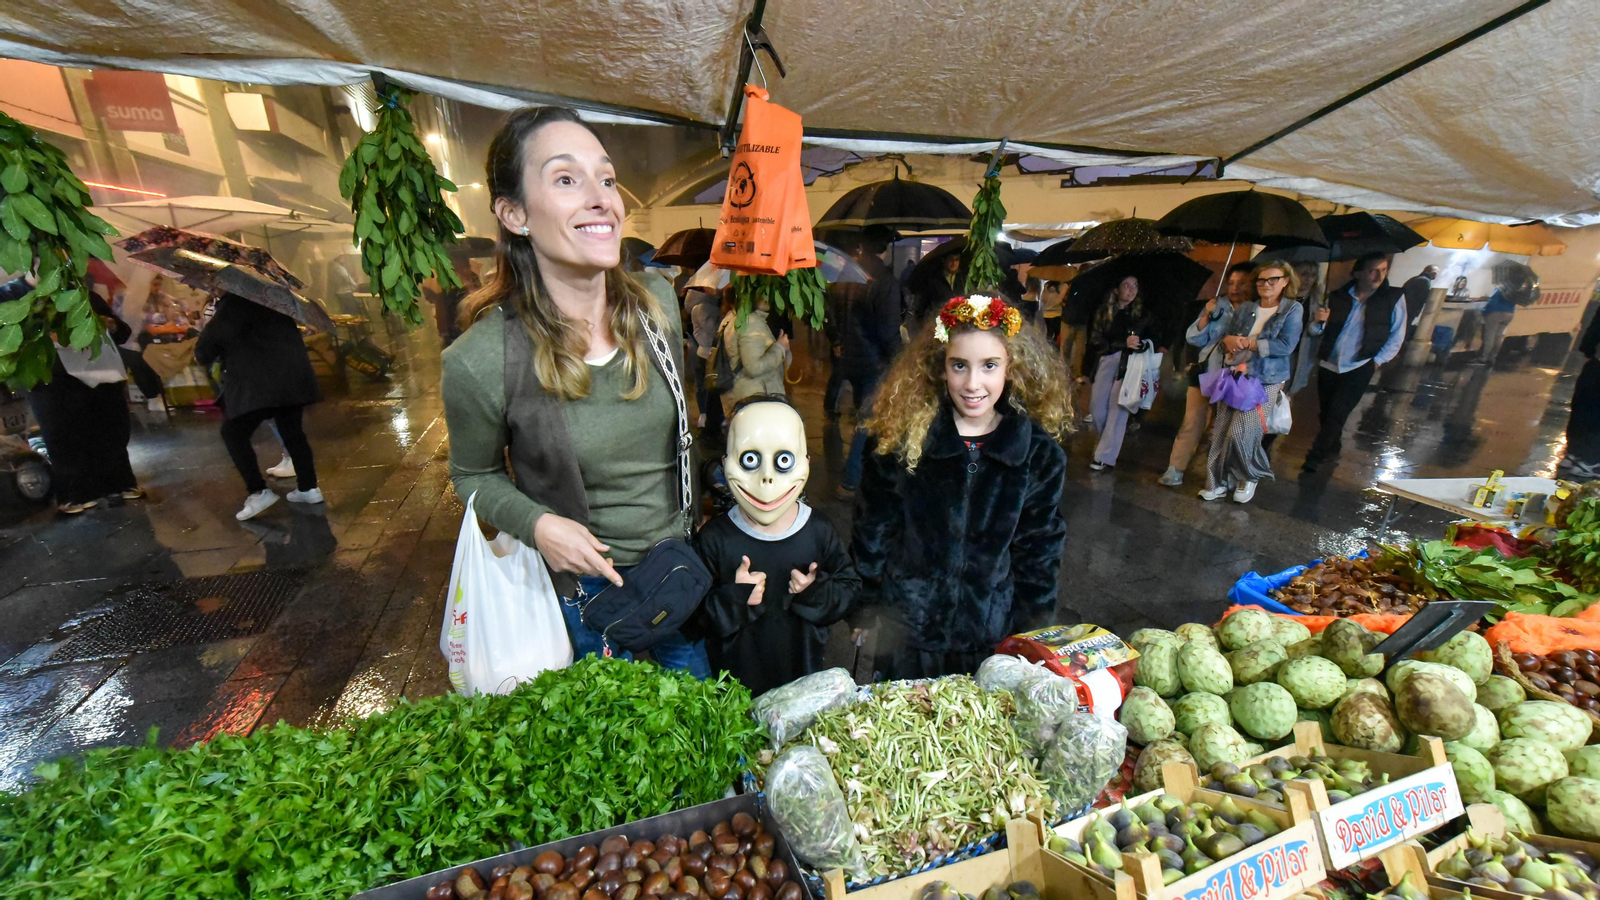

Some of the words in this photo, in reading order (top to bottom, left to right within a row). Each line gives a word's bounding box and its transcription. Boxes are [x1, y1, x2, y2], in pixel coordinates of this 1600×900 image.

[106, 105, 165, 121] suma
[1335, 801, 1391, 854] David
[1390, 797, 1408, 829] &
[1405, 785, 1448, 829] Pilar
[1239, 864, 1258, 898] &
[1258, 844, 1309, 898] Pilar
